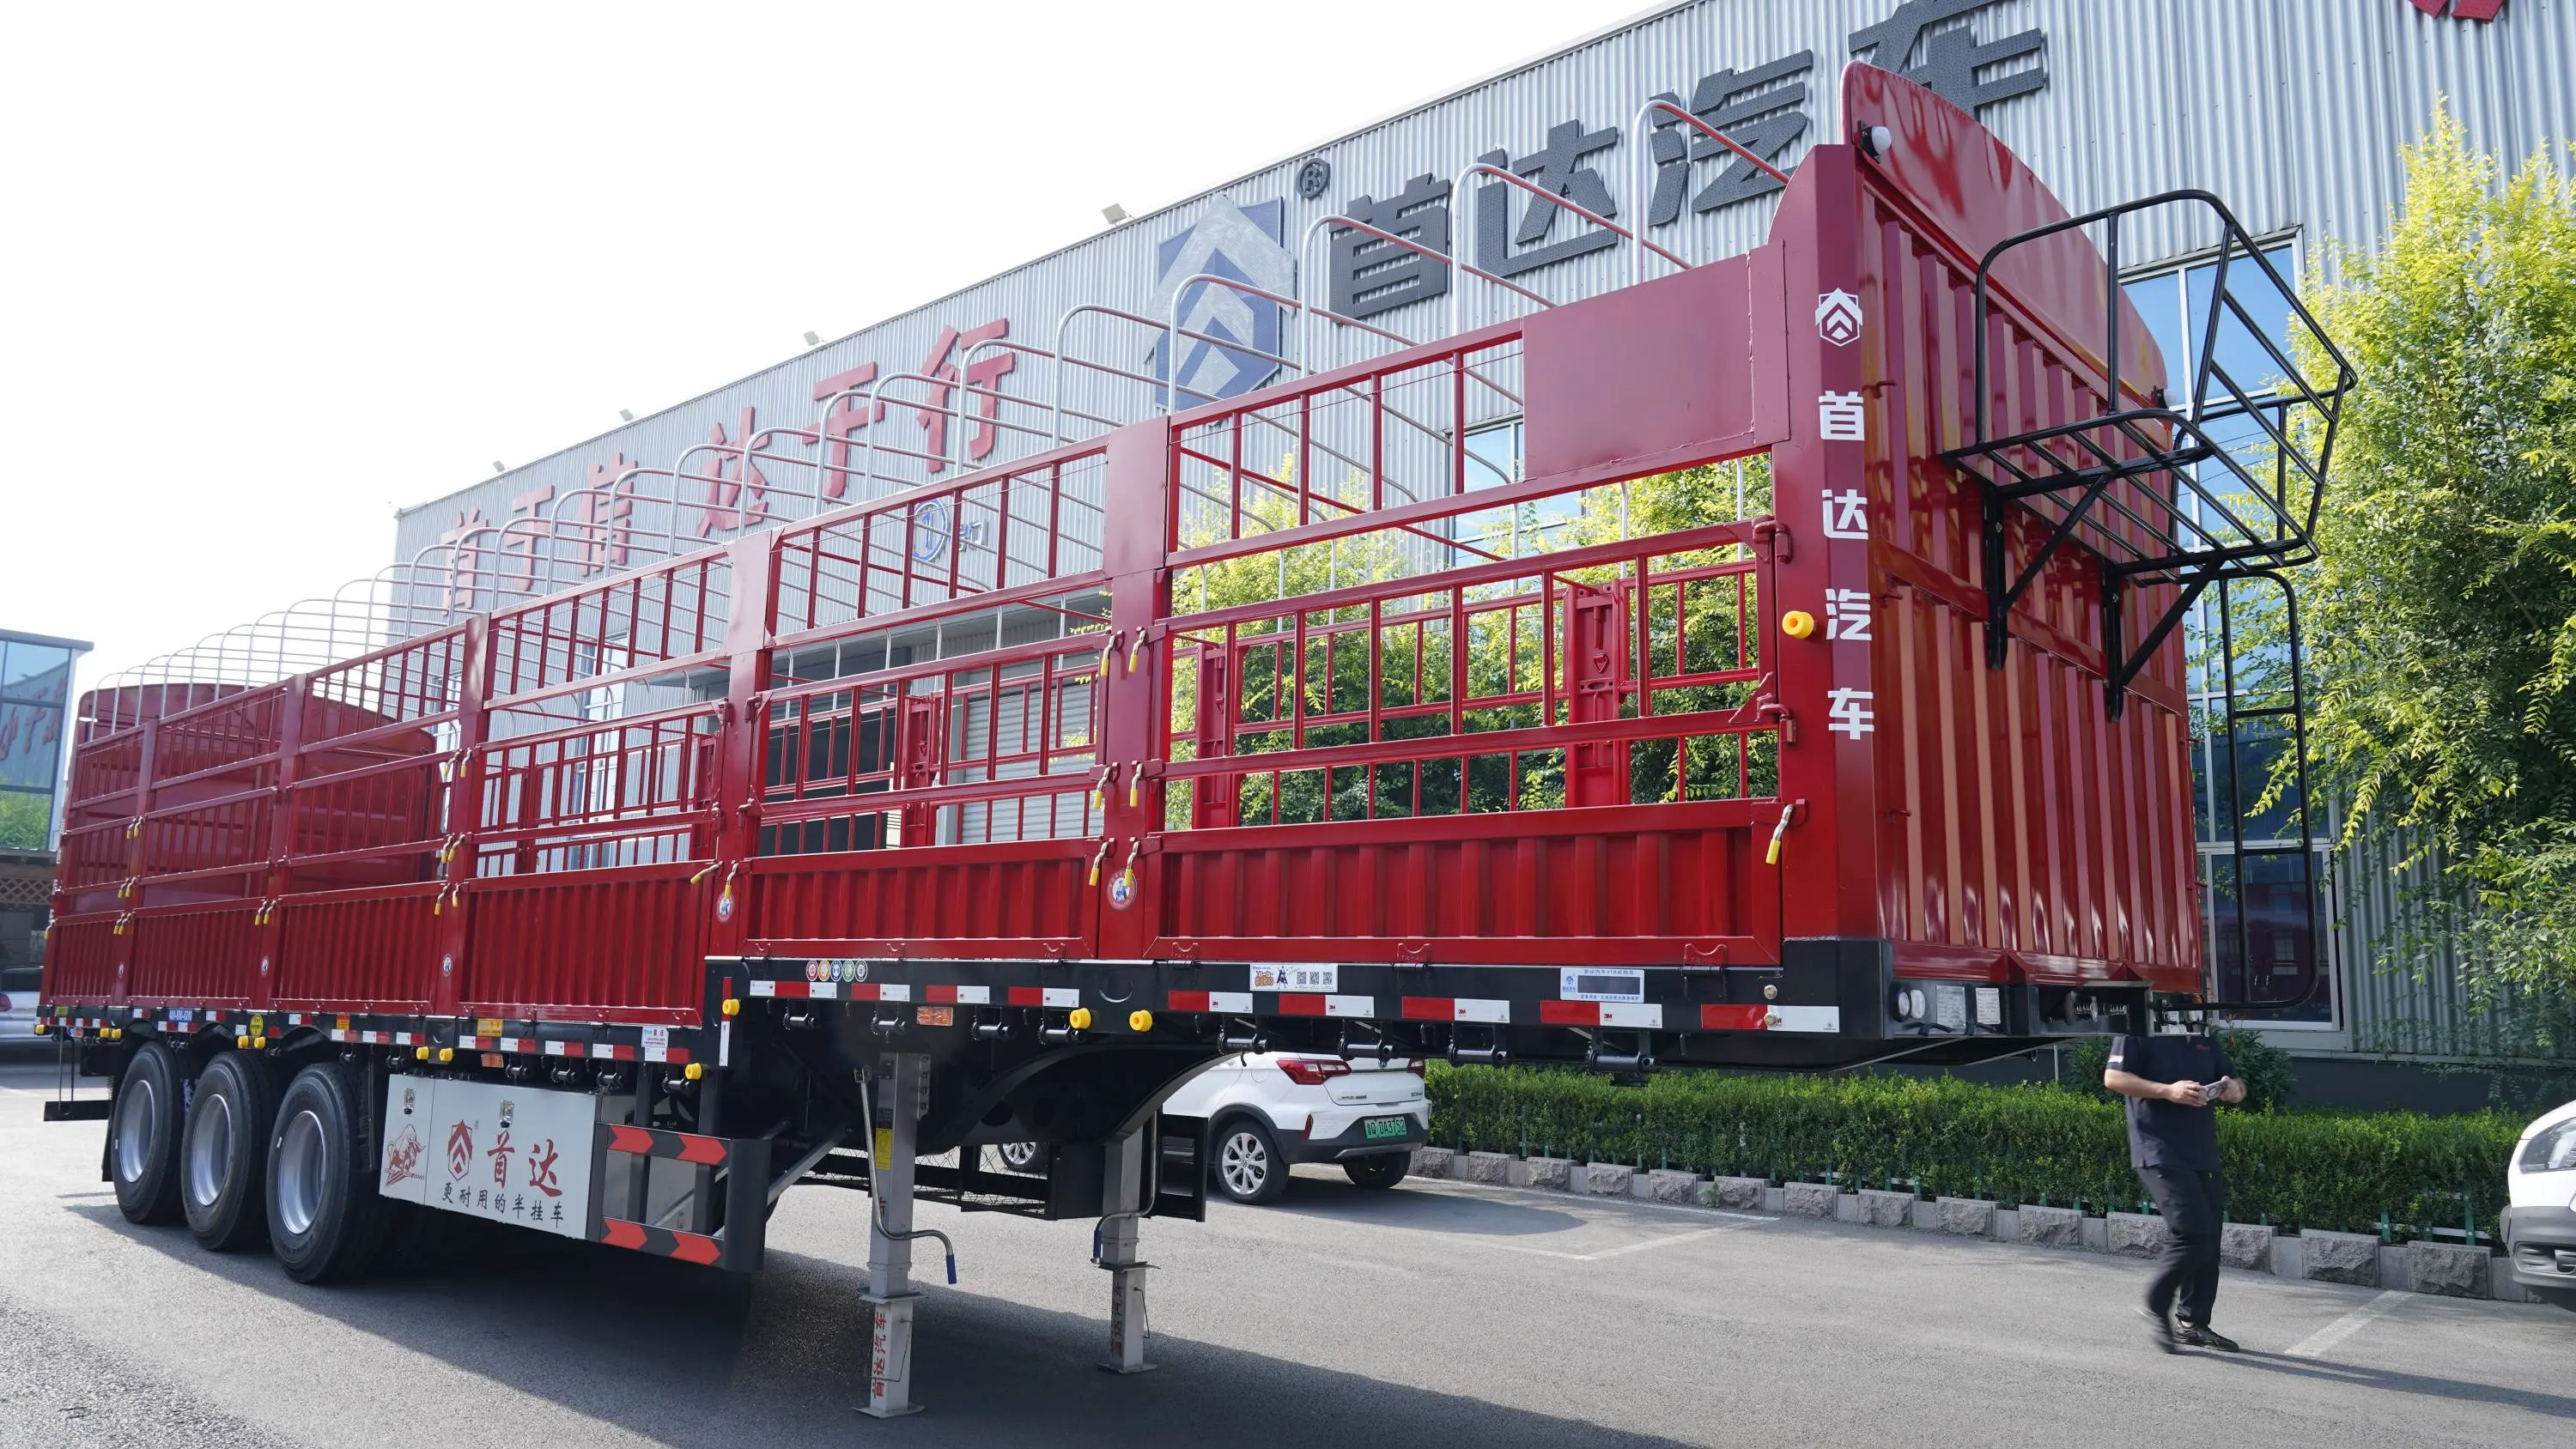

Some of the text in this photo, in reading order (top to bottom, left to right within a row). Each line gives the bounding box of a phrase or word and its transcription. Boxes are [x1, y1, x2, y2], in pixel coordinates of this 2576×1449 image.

[1329, 0, 2044, 318] 首达汽车
[696, 317, 1016, 538] 达于行
[1819, 391, 1874, 740] 首达汽车
[441, 1181, 564, 1228] 更耐用的半挂车
[487, 1131, 563, 1197] 首达
[872, 1311, 887, 1399] 首达汽车
